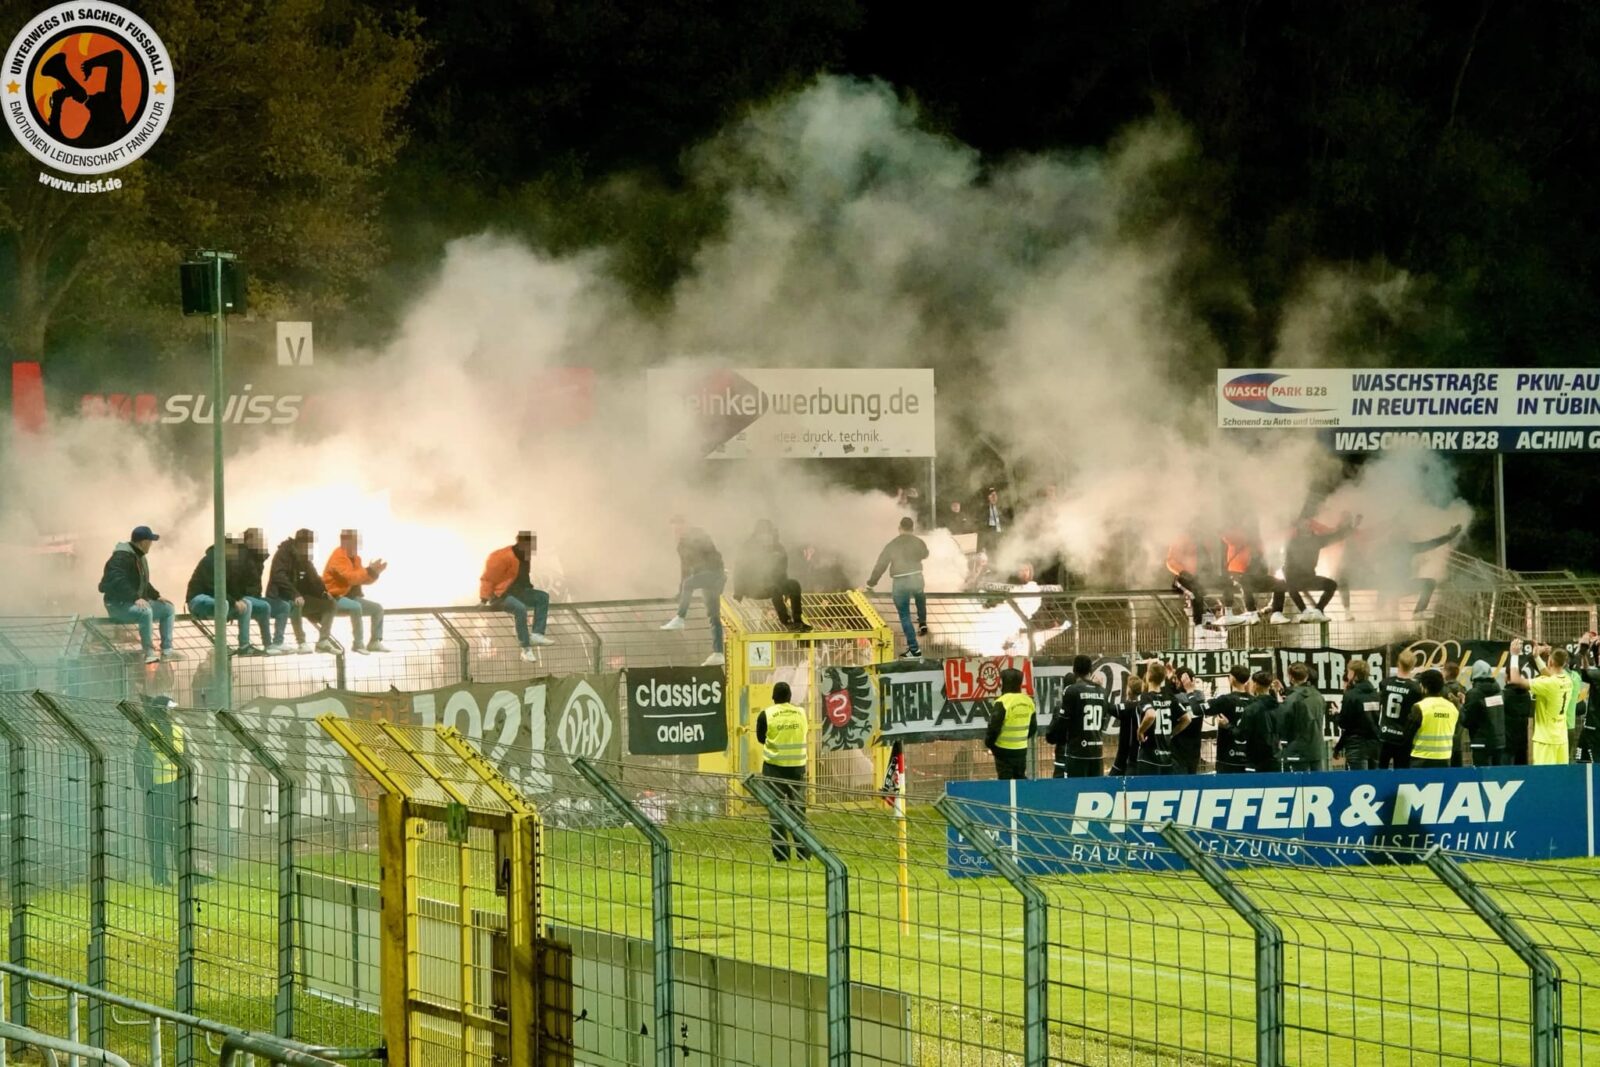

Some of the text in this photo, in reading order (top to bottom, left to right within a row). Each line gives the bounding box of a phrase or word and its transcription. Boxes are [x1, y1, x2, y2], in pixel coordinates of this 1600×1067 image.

[285, 337, 306, 363] V
[1223, 386, 1328, 397] WASCH PARK B28
[1351, 373, 1499, 396] WASCHSTRAßE
[161, 384, 303, 424] swiss
[1351, 397, 1499, 416] IN REUTLINGEN
[1516, 397, 1539, 415] IN
[1222, 417, 1261, 427] Schonend
[1273, 418, 1292, 426] Auto
[1309, 417, 1341, 426] Umwelt
[839, 429, 883, 443] technik.
[1461, 431, 1500, 450] B28
[1516, 431, 1585, 450] ACHIM
[1280, 649, 1383, 692] UTRS
[635, 676, 722, 708] classics
[878, 675, 934, 732] CREW
[1558, 691, 1568, 716] 1
[1083, 704, 1103, 731] 20
[1386, 692, 1403, 719] 6
[656, 721, 705, 743] aalen
[1154, 707, 1173, 736] 15
[1071, 780, 1525, 836] PFEIFFER & MAY
[1335, 830, 1518, 855] HAUSTECHNIK
